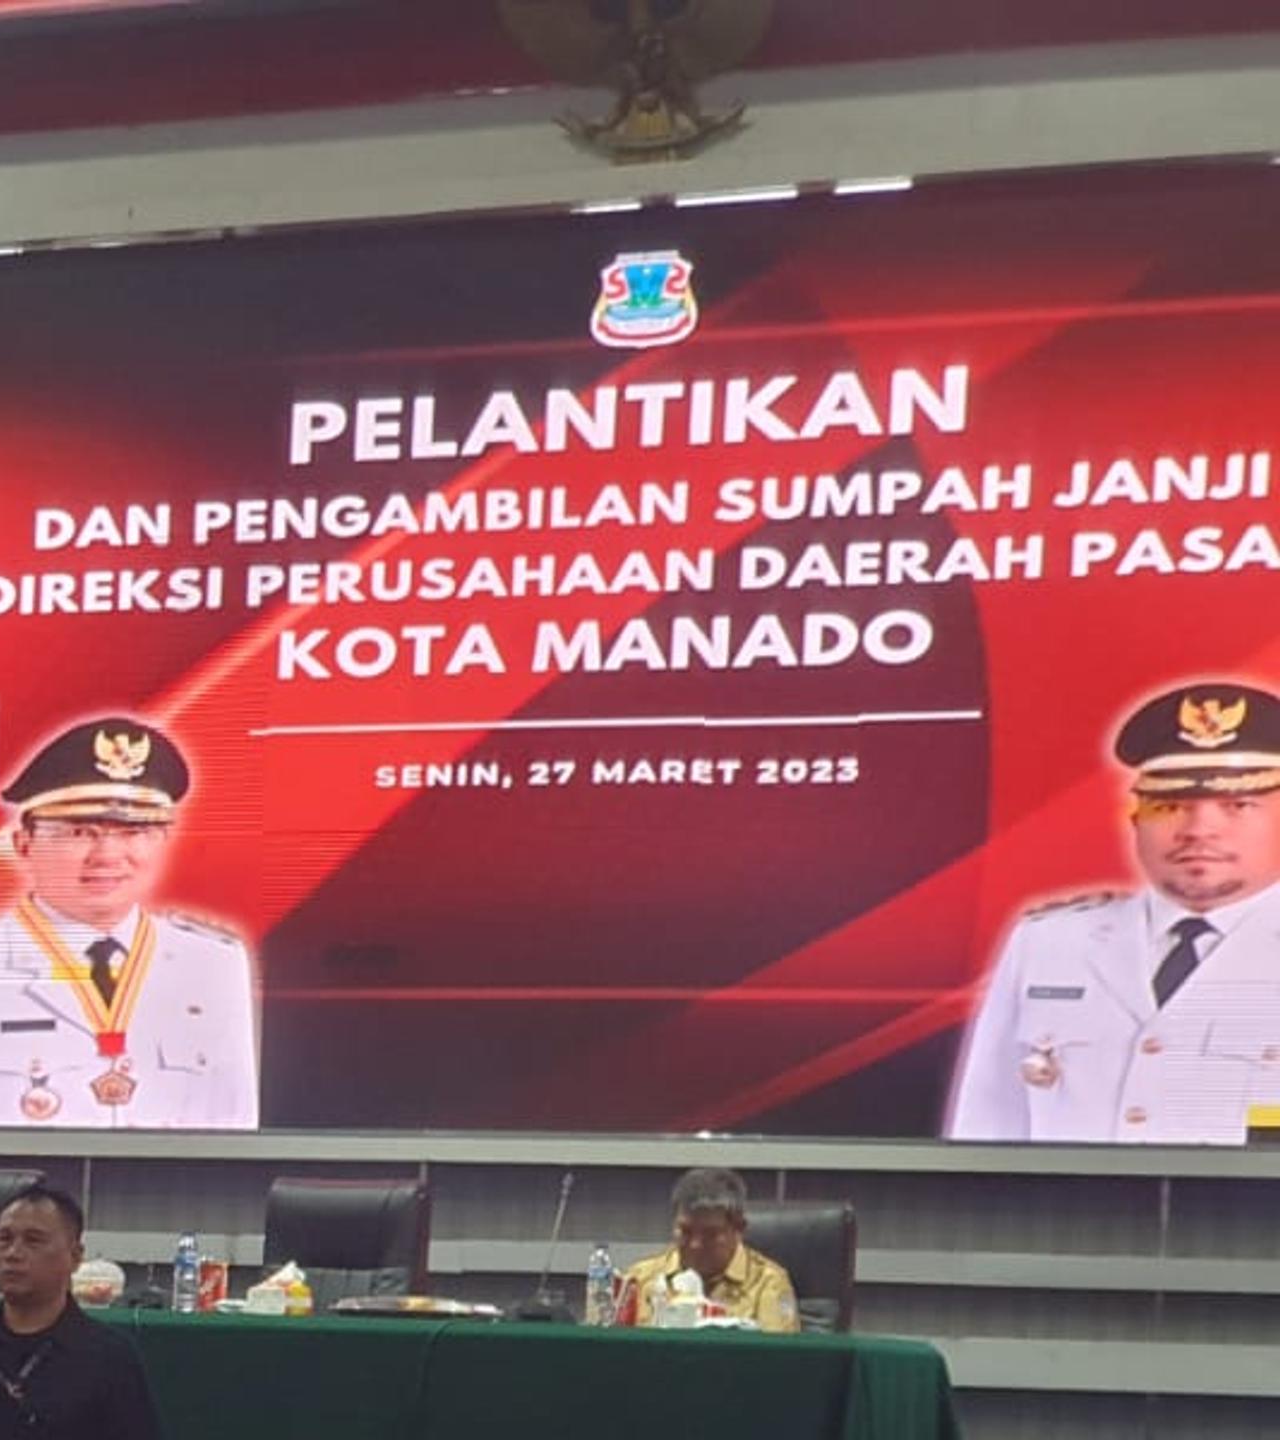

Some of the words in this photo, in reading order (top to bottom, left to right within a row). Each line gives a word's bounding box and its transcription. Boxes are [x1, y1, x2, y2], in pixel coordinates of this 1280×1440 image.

[290, 364, 969, 465] PELANTIKAN
[34, 504, 171, 550] DAN
[194, 481, 689, 544] PENGAMBILAN
[715, 464, 1032, 522] SUMPAH
[1054, 452, 1270, 507] JANJI
[247, 548, 714, 607] PERUSAHAAN
[740, 534, 1044, 589] DAERAH
[278, 624, 505, 679] KOTA
[532, 609, 933, 672] MANADO
[375, 762, 512, 789] SENIN,
[529, 761, 576, 785] 27
[593, 759, 741, 784] MARET
[757, 757, 859, 784] 2023
